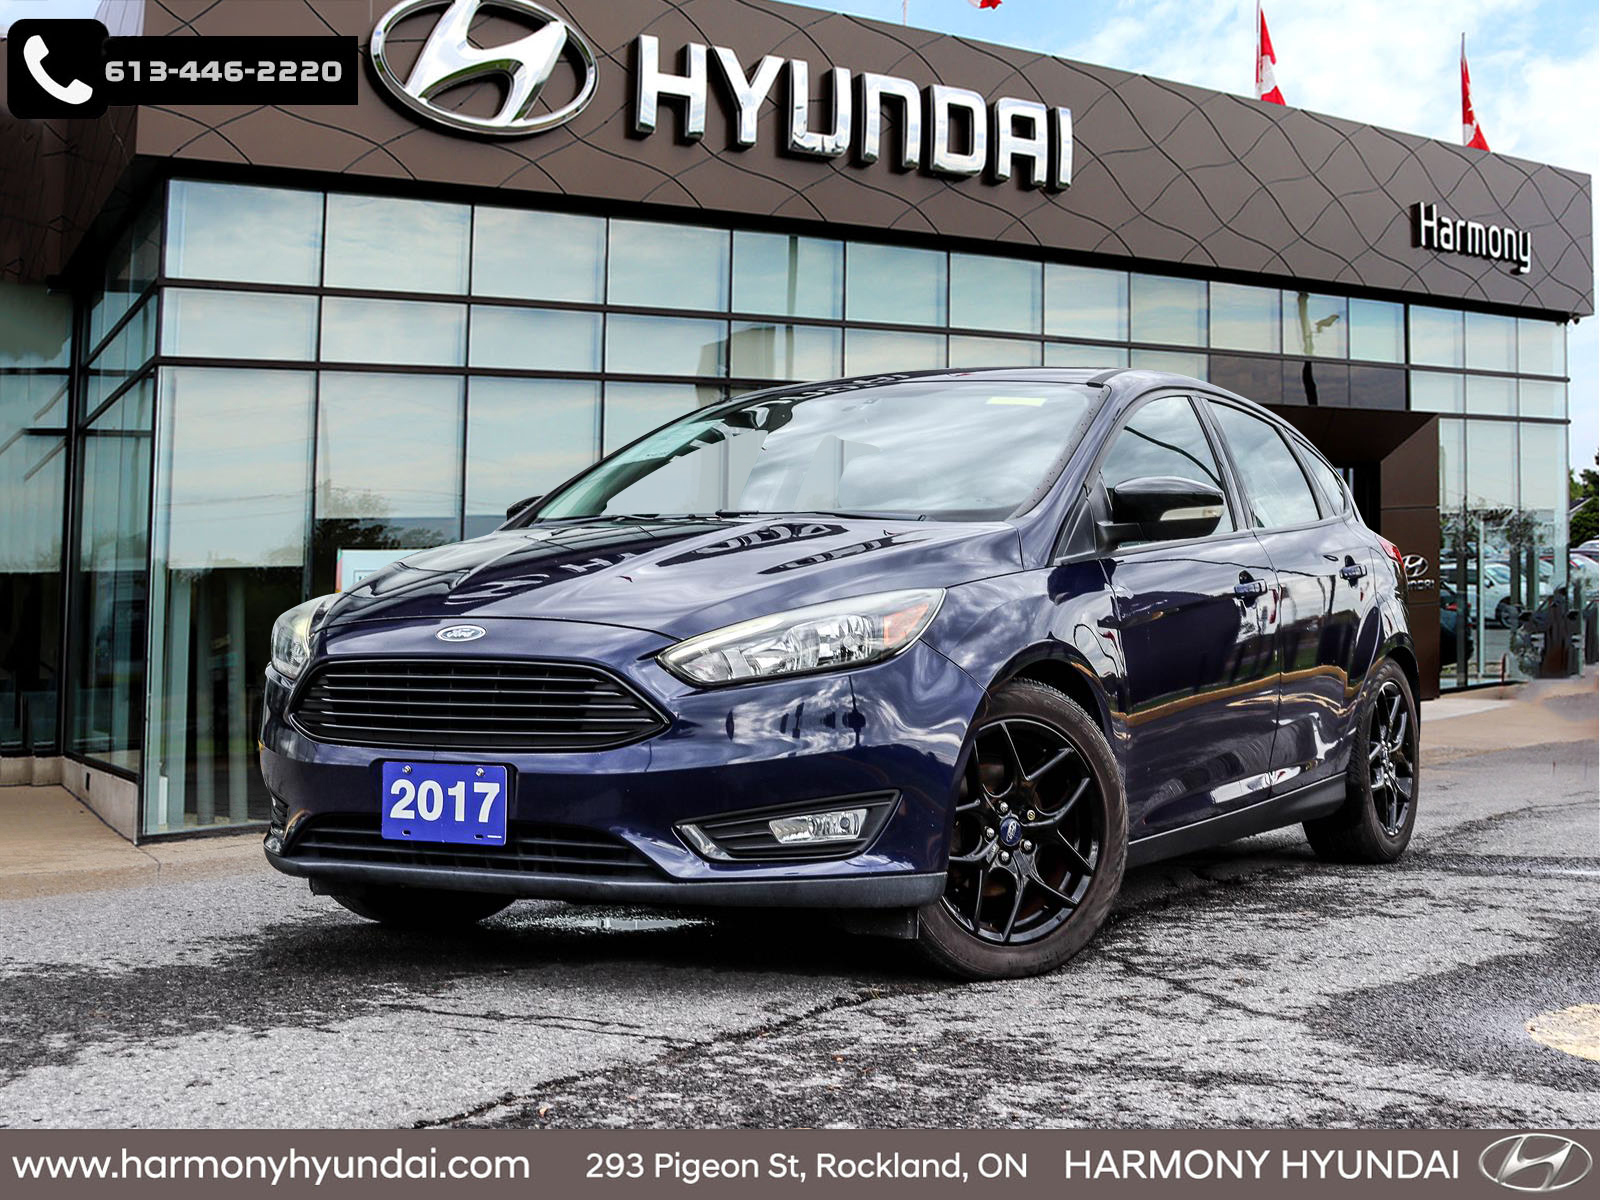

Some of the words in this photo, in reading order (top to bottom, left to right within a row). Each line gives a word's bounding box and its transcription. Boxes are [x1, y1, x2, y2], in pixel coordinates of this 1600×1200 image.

[635, 34, 1074, 191] HYUNDAI
[1419, 201, 1532, 273] Harmony
[389, 778, 500, 823] 2017
